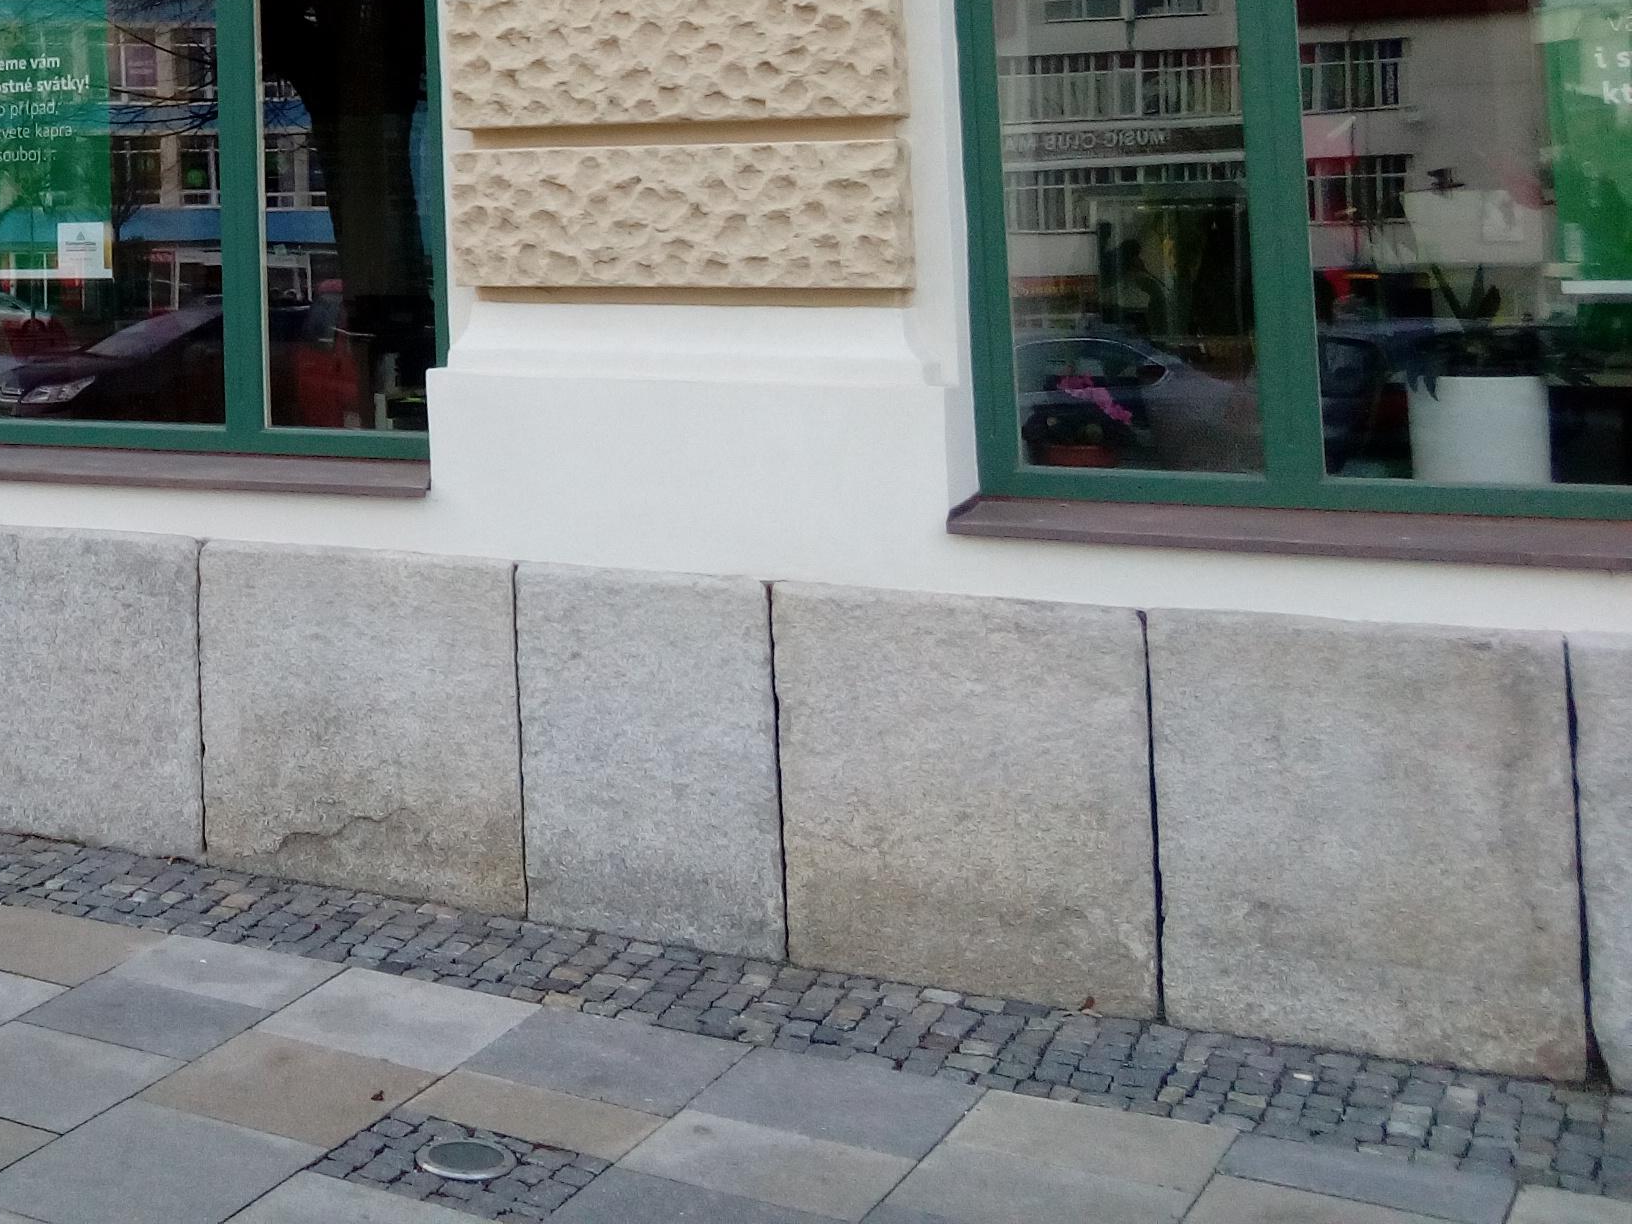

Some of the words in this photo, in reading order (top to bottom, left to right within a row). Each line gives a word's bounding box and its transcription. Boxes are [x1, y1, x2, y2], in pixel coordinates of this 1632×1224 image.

[30, 52, 61, 70] vám
[36, 74, 90, 94] svátky!
[35, 122, 73, 140] kapra
